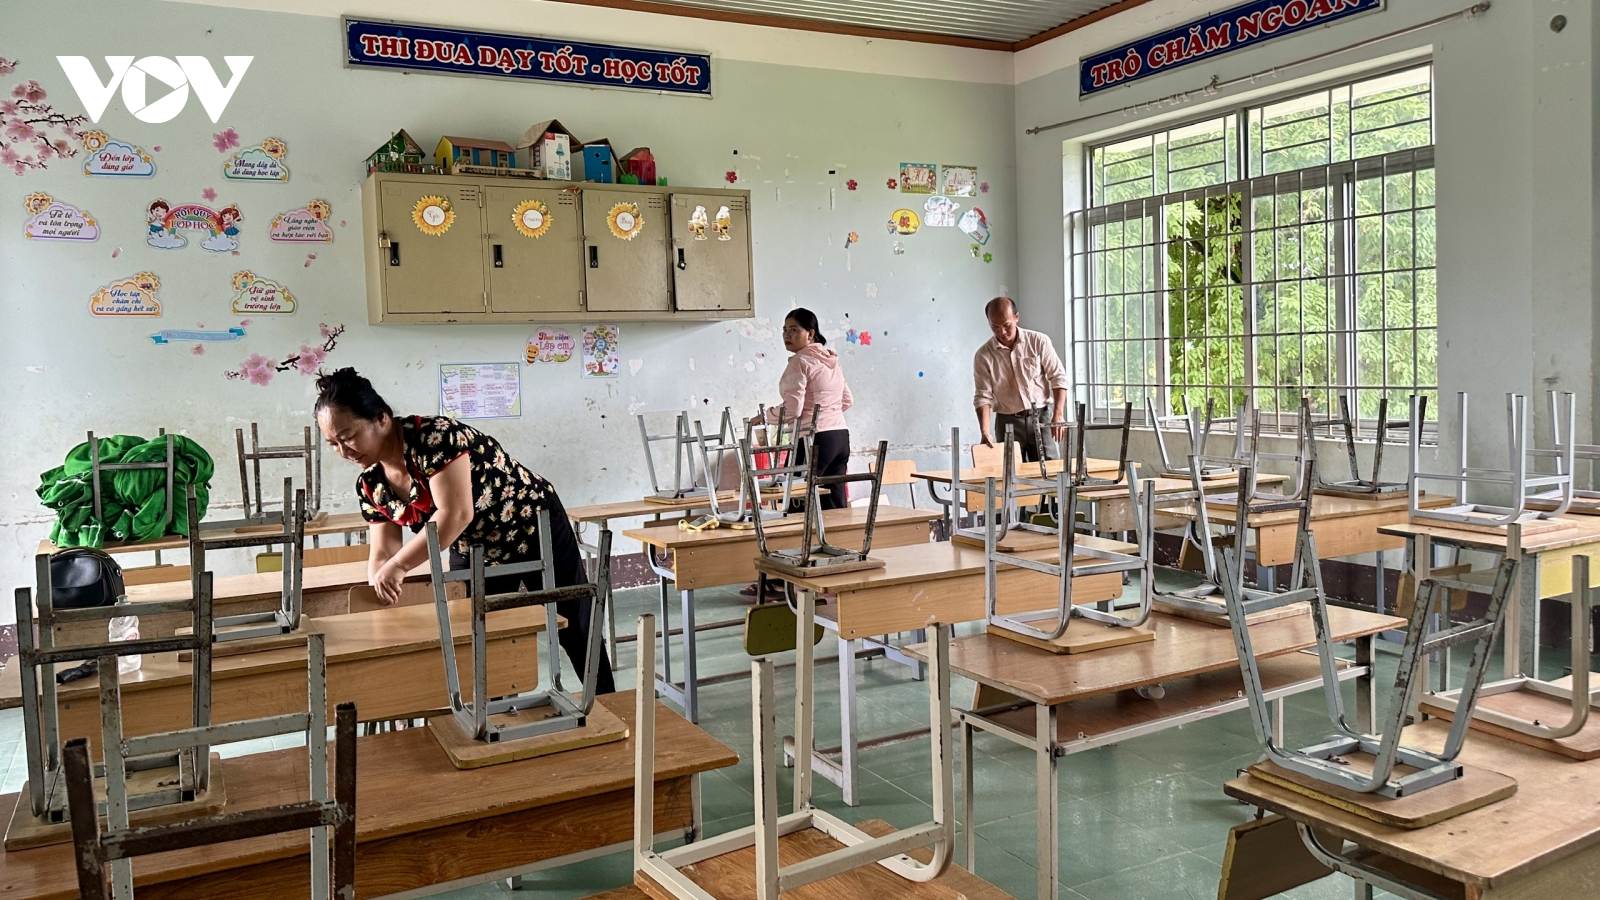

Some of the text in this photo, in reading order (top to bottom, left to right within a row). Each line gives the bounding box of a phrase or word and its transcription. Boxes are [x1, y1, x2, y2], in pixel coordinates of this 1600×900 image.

[360, 34, 411, 59] THI
[414, 39, 475, 65] ĐUA
[478, 46, 535, 73] DẠY
[539, 45, 588, 75] TỐT
[603, 58, 652, 83] HỌC
[655, 57, 700, 85] TỐT
[1090, 48, 1142, 88] TRÒ
[1147, 24, 1231, 68] CHĂM
[99, 152, 135, 163] Đến lớp
[101, 162, 134, 172] đúng giờ
[234, 159, 256, 169] Mang
[257, 168, 268, 176] học
[49, 209, 64, 218] Tử
[174, 207, 212, 219] NỘI QUY
[63, 220, 84, 229] trọng
[193, 220, 217, 231] HỌC
[42, 228, 81, 237] mọi người
[110, 289, 141, 298] Học tập
[249, 286, 265, 295] Giữ
[244, 302, 281, 311] trường lớp
[538, 331, 554, 341] Thư
[539, 341, 569, 351] Lớp em
